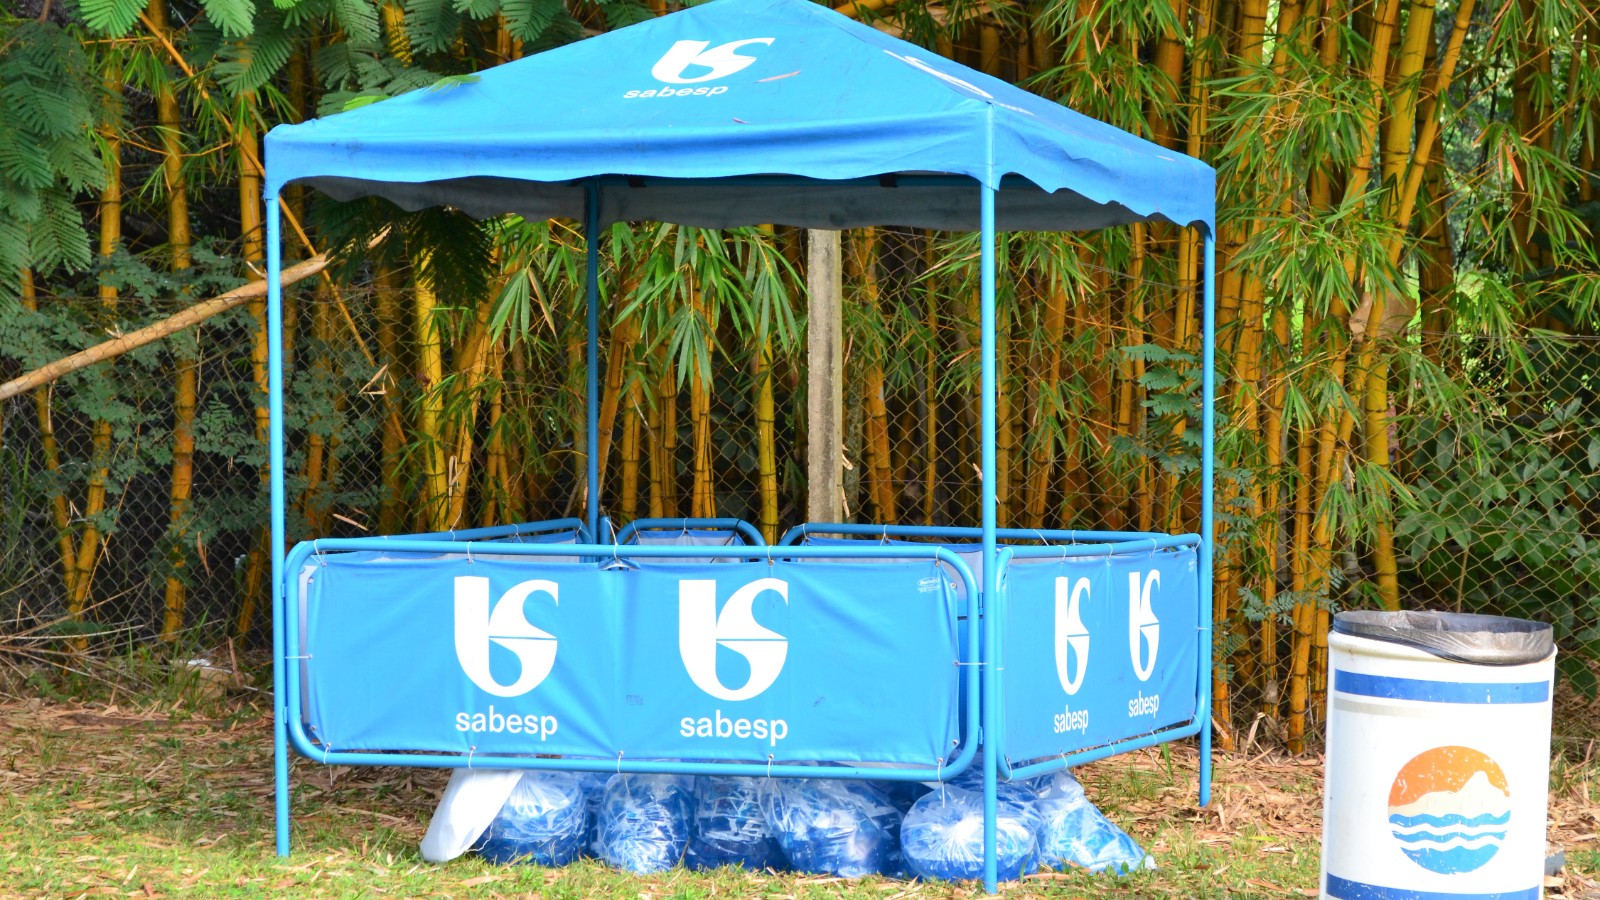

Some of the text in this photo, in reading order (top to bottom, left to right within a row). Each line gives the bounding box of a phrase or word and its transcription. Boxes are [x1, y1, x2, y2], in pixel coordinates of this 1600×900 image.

[623, 86, 729, 98] sabesp
[1054, 704, 1089, 735] sabesp
[1129, 690, 1160, 718] sabesp
[455, 705, 558, 741] sabesp
[680, 710, 788, 746] sabesp
